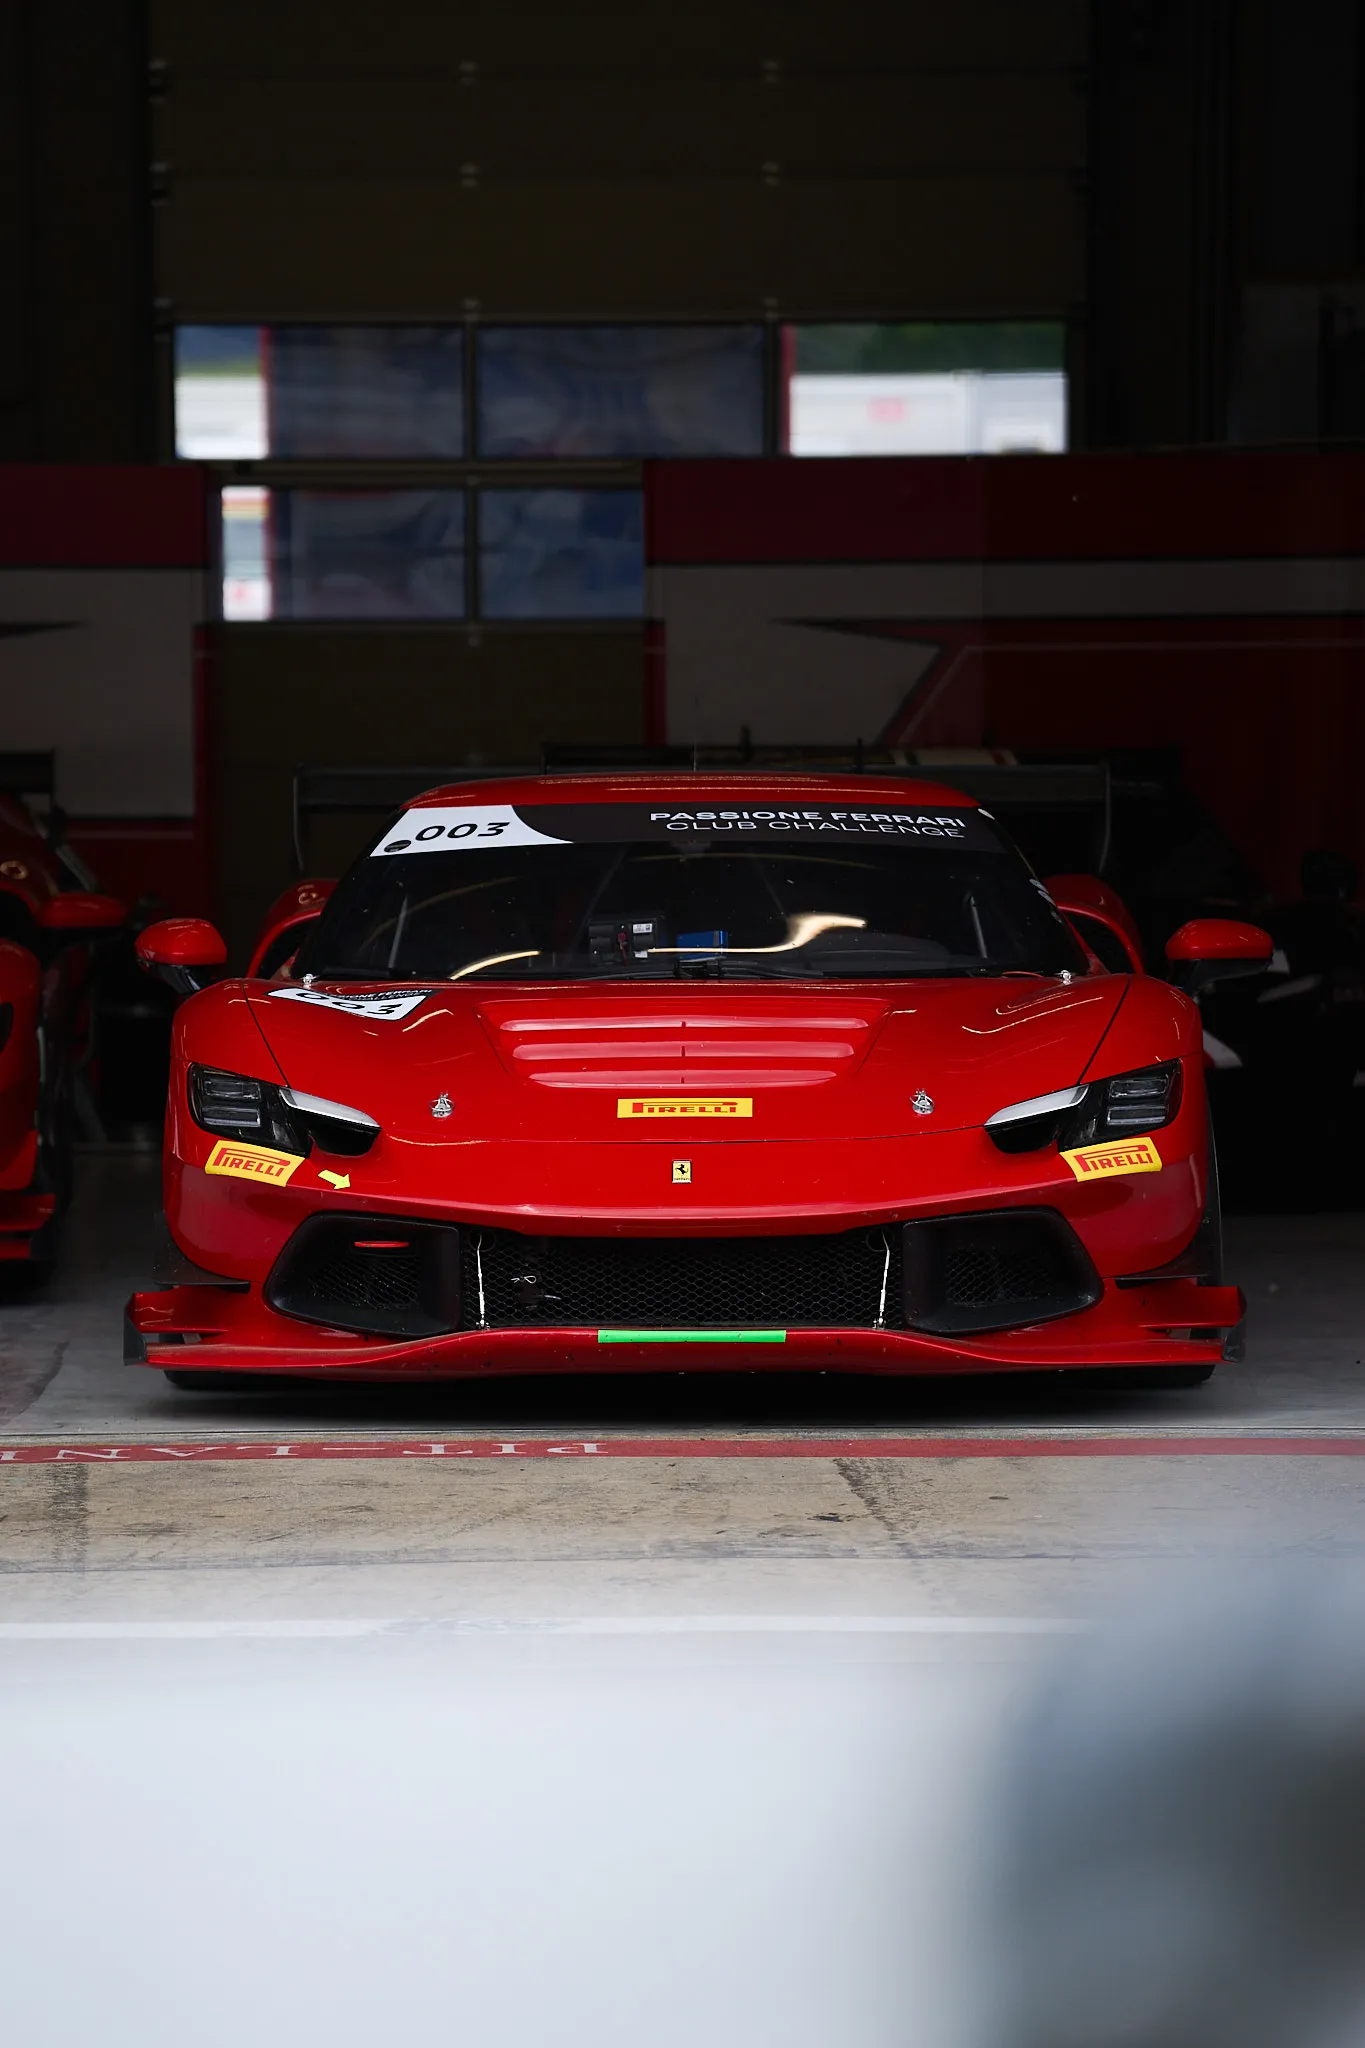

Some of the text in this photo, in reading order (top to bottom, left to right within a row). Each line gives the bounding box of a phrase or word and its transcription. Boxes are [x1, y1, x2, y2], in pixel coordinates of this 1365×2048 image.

[650, 811, 966, 828] PASSIONE FERRARI
[415, 821, 511, 842] 003
[666, 821, 965, 838] CLUB CHALLENGE
[632, 1101, 738, 1114] PIRELLI
[212, 1147, 291, 1177] PIRELLI
[1073, 1144, 1154, 1173] PIRELLI
